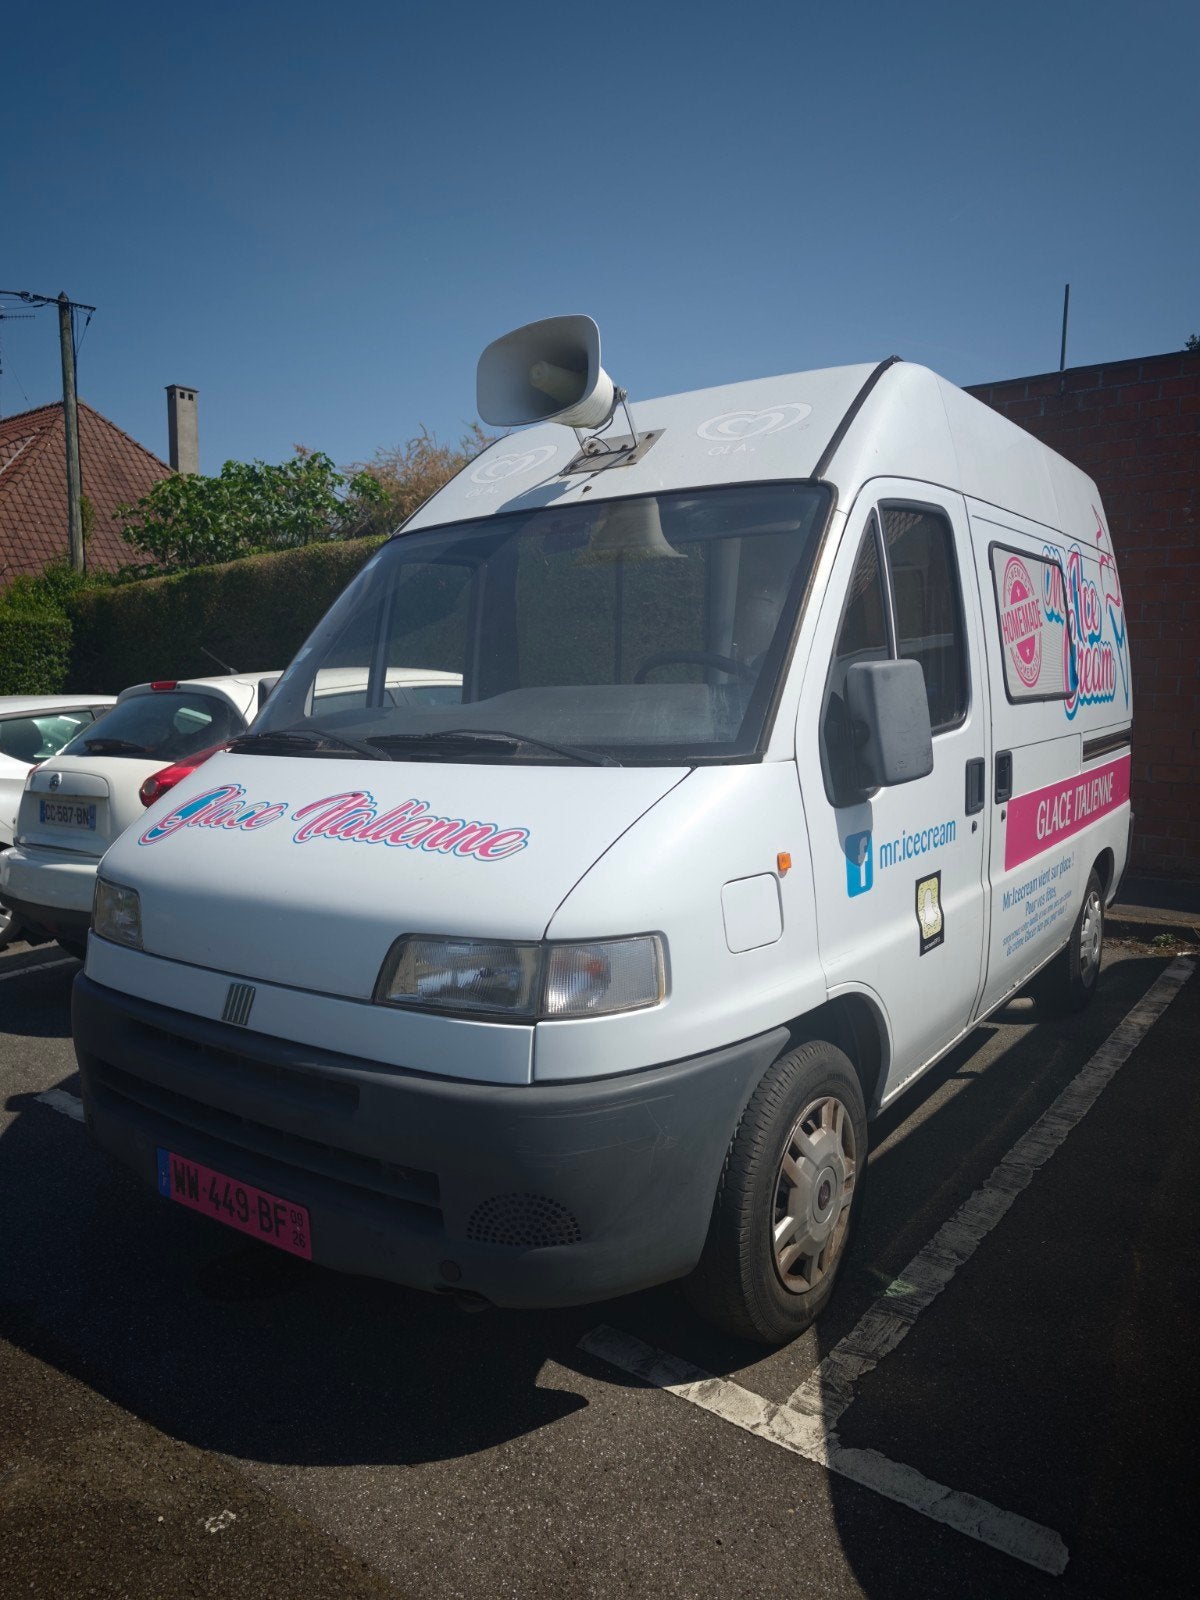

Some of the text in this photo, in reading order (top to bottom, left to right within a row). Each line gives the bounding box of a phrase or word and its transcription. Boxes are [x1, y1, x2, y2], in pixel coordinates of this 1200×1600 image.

[1001, 599, 1043, 645] HOMEMADE
[1064, 609, 1116, 718] Cream
[138, 784, 531, 862] Glace Italienne
[1036, 772, 1114, 840] GLACE ITALIENNE
[879, 820, 956, 869] mr.icecream
